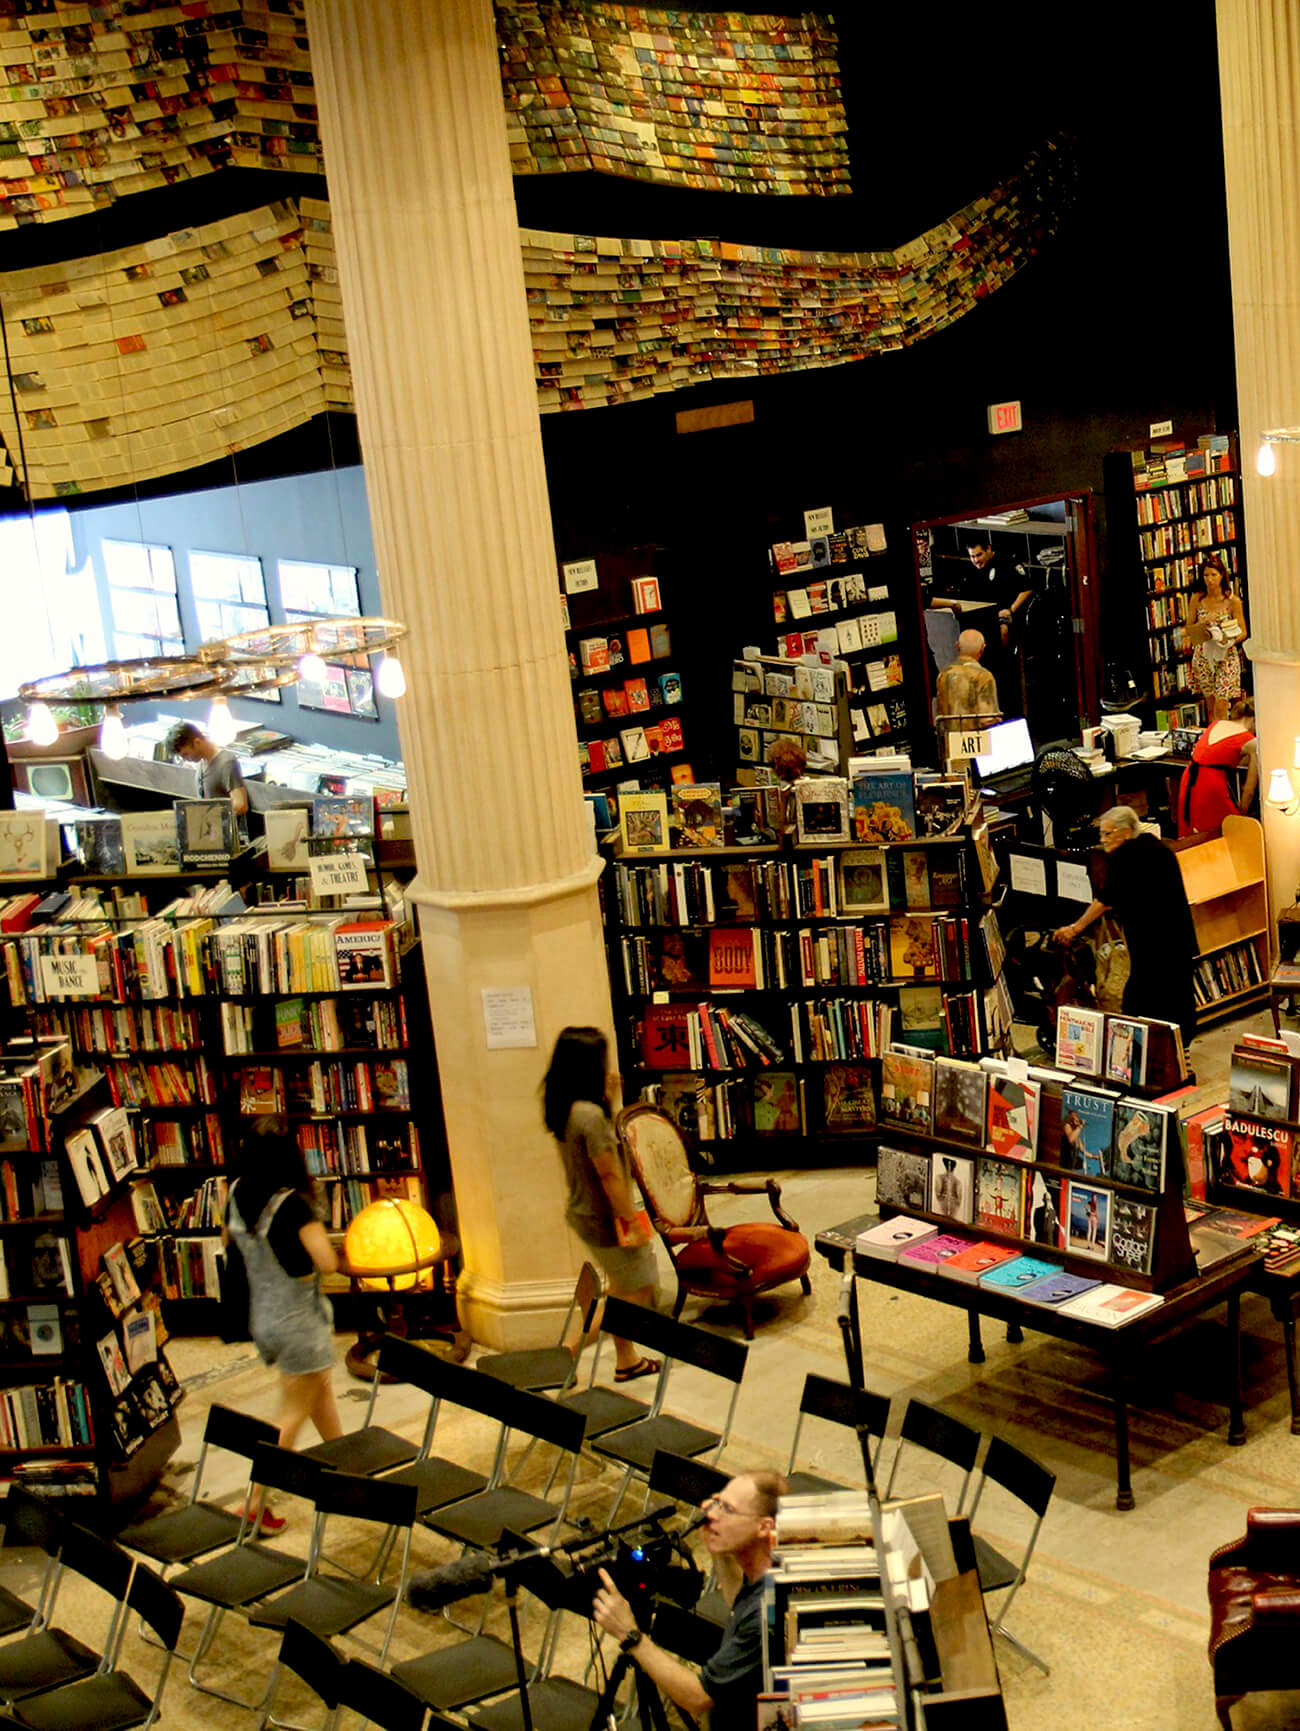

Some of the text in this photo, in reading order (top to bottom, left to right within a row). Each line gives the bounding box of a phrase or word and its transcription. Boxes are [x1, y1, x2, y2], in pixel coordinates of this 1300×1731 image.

[996, 405, 1017, 429] EXIT
[961, 737, 982, 753] ART
[330, 871, 360, 885] THEATRE
[51, 960, 77, 974] MUSIC
[714, 944, 753, 975] BODY
[58, 975, 84, 988] DANCE
[1064, 1093, 1109, 1112] TRUST
[1225, 1119, 1289, 1143] BADULESCU
